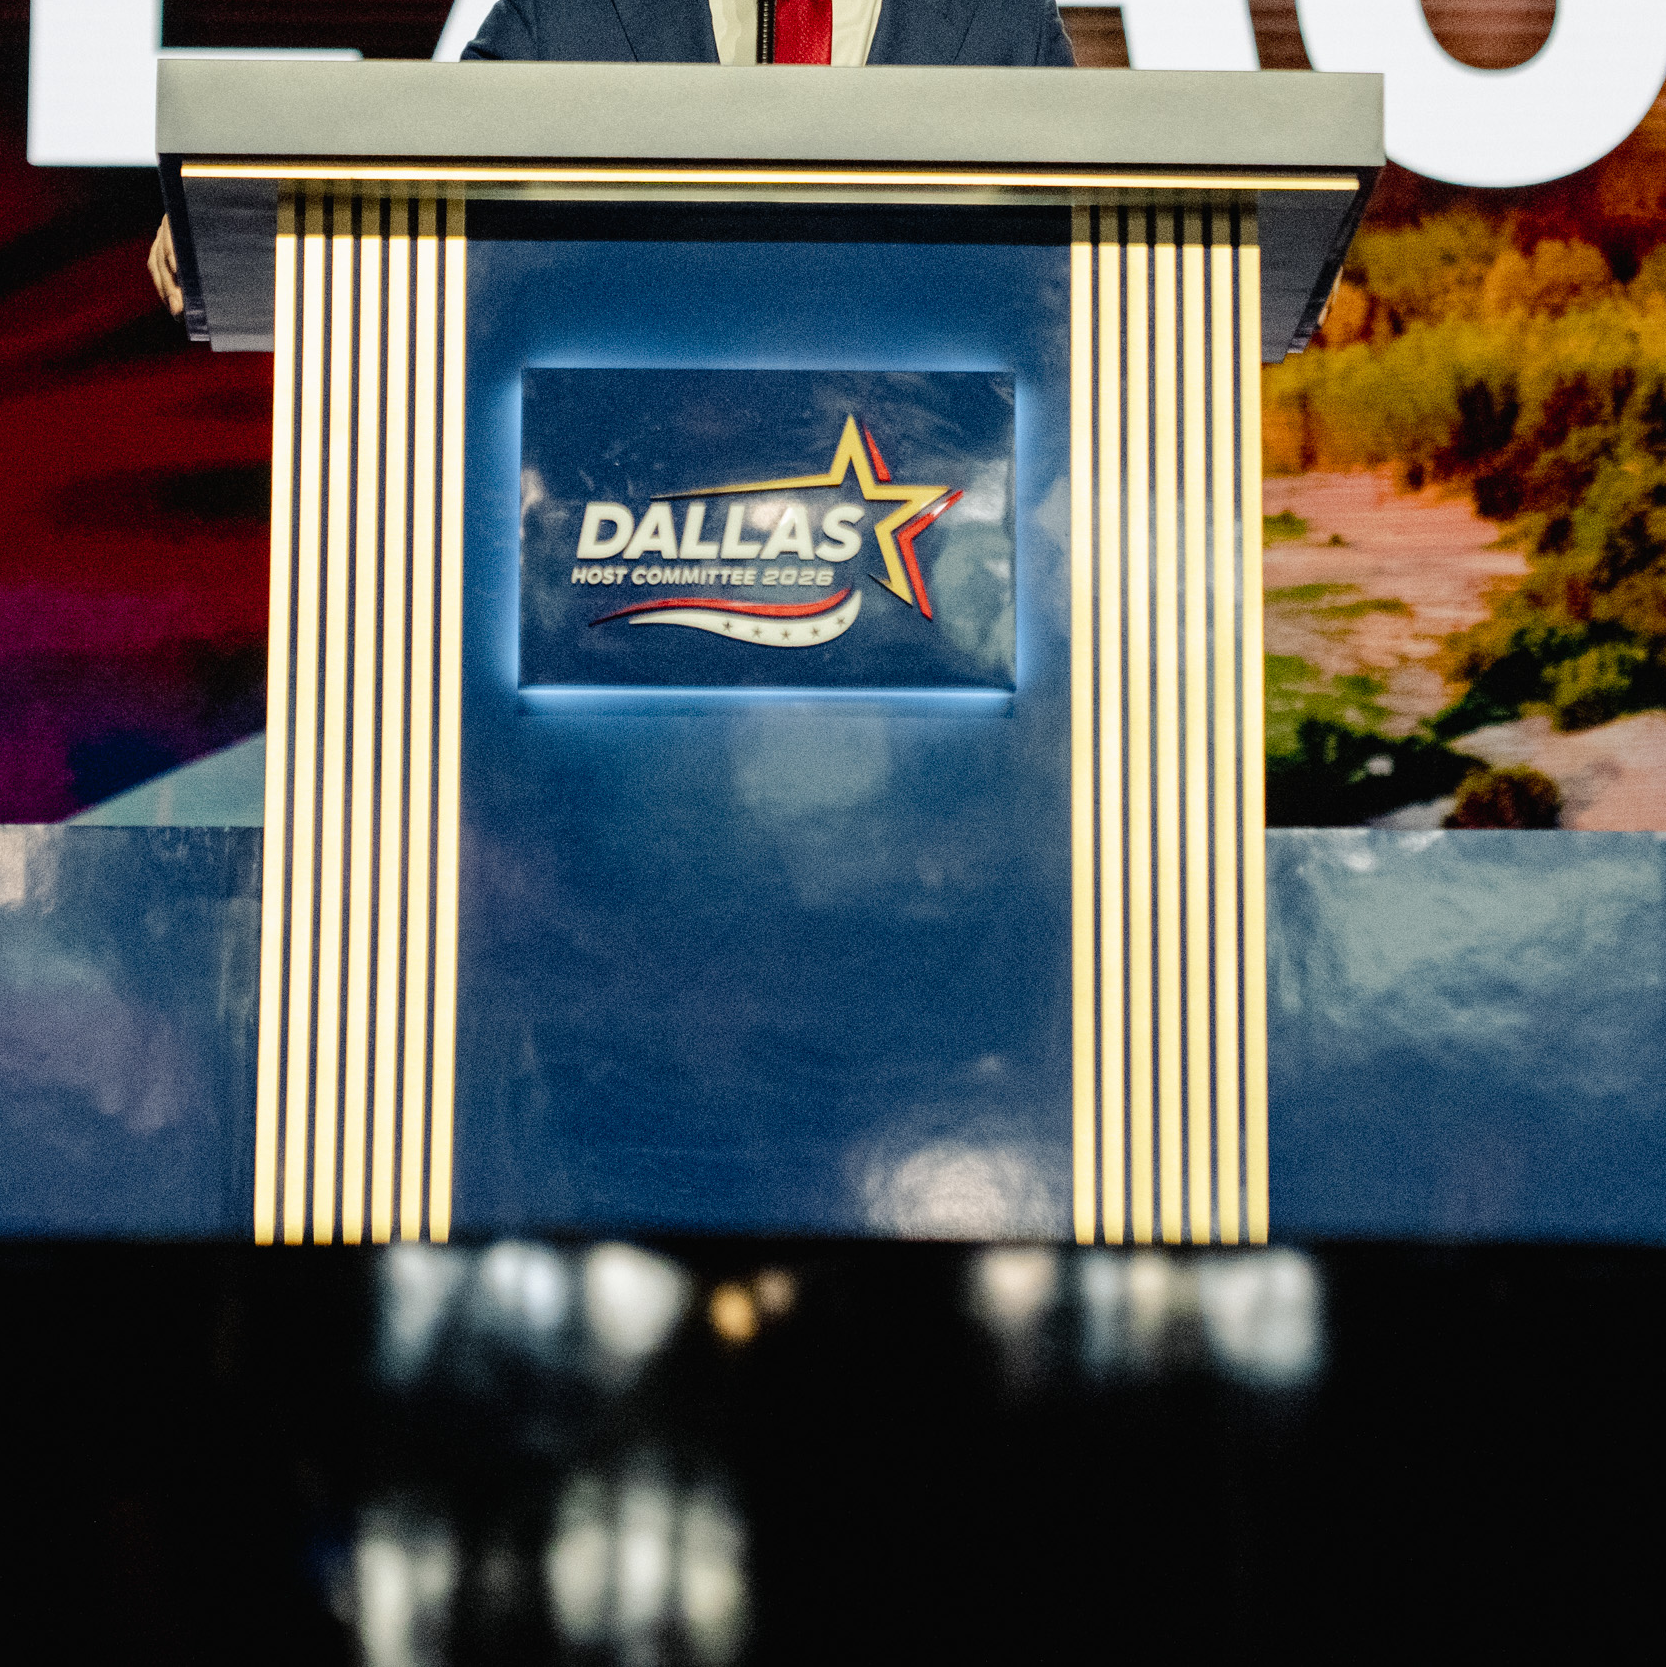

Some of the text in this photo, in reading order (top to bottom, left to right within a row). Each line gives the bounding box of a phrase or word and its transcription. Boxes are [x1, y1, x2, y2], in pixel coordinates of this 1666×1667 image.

[575, 501, 865, 562] DALLAS
[571, 566, 834, 586] HOST COMMITTEE 2026
